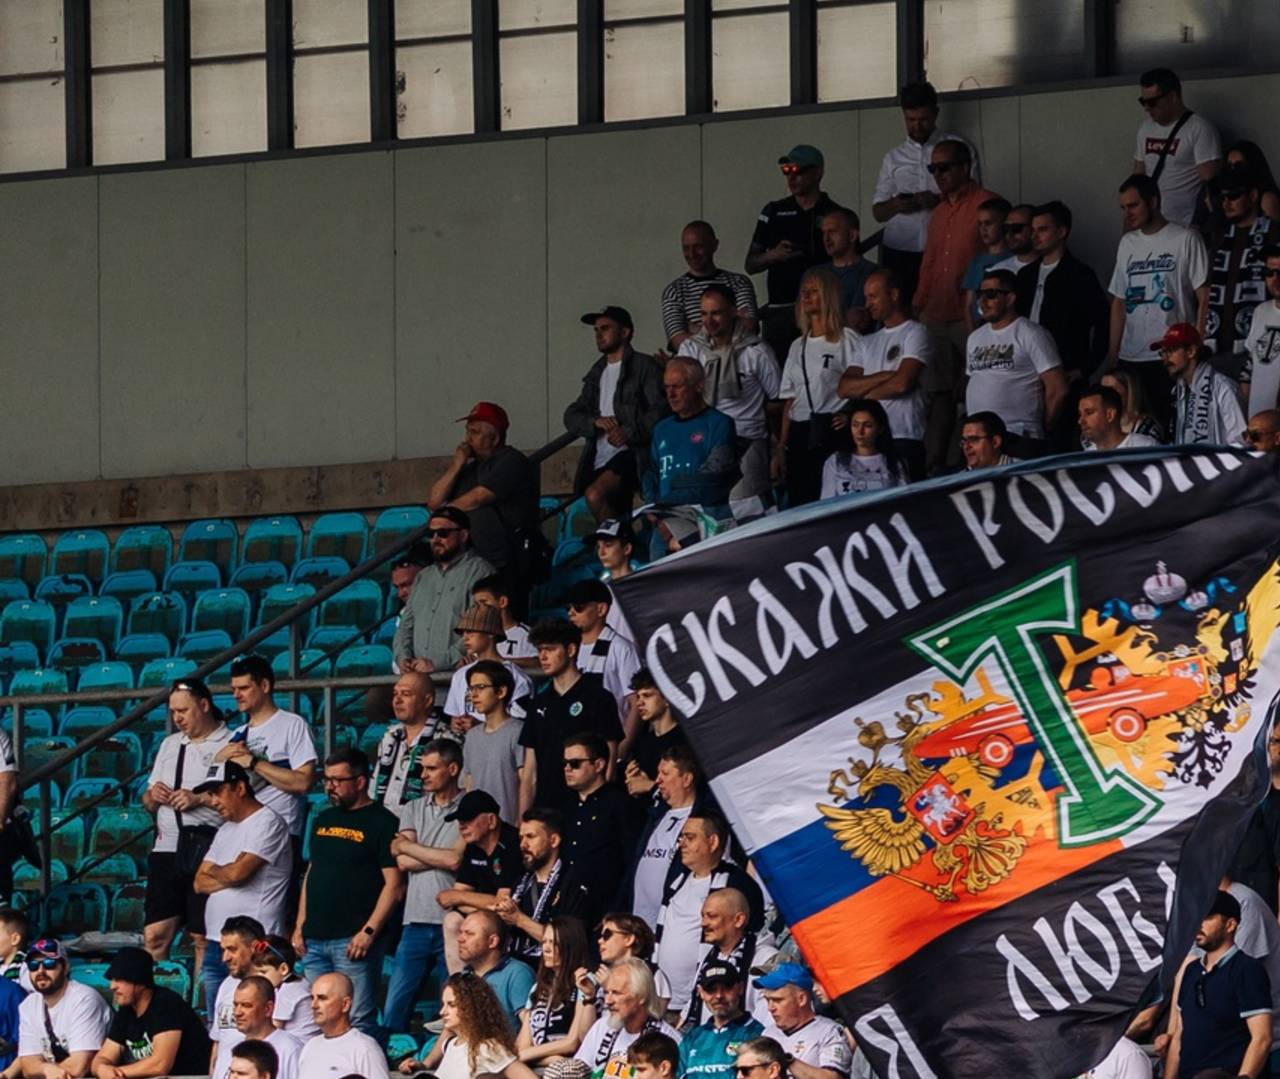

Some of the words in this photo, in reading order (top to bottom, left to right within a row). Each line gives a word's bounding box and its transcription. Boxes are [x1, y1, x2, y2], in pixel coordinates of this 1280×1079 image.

[646, 513, 945, 718] СКАЖИ
[950, 450, 1266, 570] РОССИ
[994, 861, 1177, 1022] ЛЮБ
